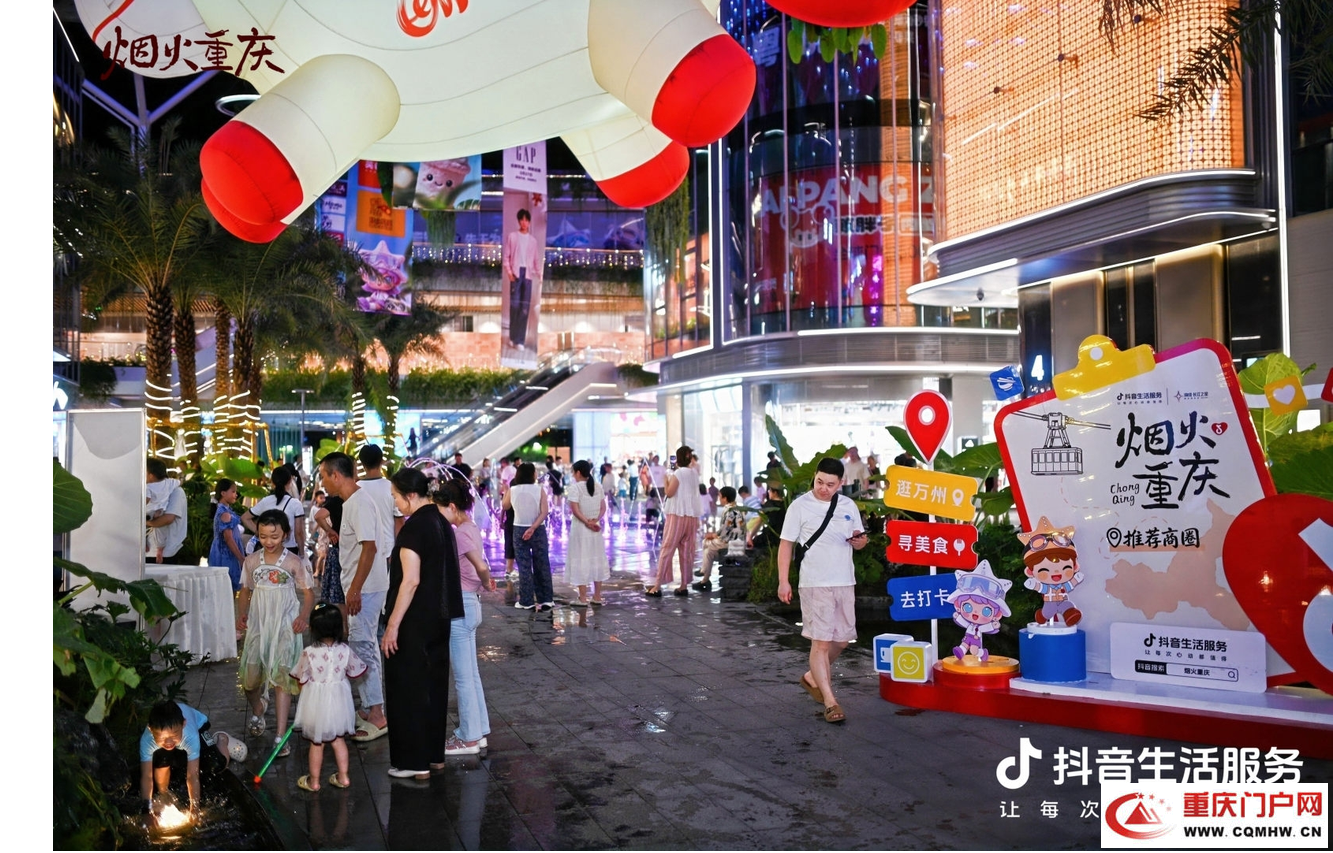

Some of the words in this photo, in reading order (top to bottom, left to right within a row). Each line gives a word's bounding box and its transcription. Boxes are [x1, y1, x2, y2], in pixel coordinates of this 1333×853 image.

[516, 145, 537, 163] GAP
[1030, 354, 1045, 381] 4
[1124, 391, 1163, 400] 抖音生活服务
[1115, 411, 1216, 468] 烟火
[1110, 482, 1141, 496] Chong
[1133, 451, 1230, 510] 重庆
[896, 479, 947, 505] 逛万州
[1111, 494, 1136, 507] Qing
[897, 534, 953, 556] 寻美食
[1123, 527, 1200, 549] 推荐商圈
[900, 588, 951, 609] 去打卡
[1158, 636, 1228, 653] 抖音生活服务
[1184, 667, 1210, 676] 烟火重庆
